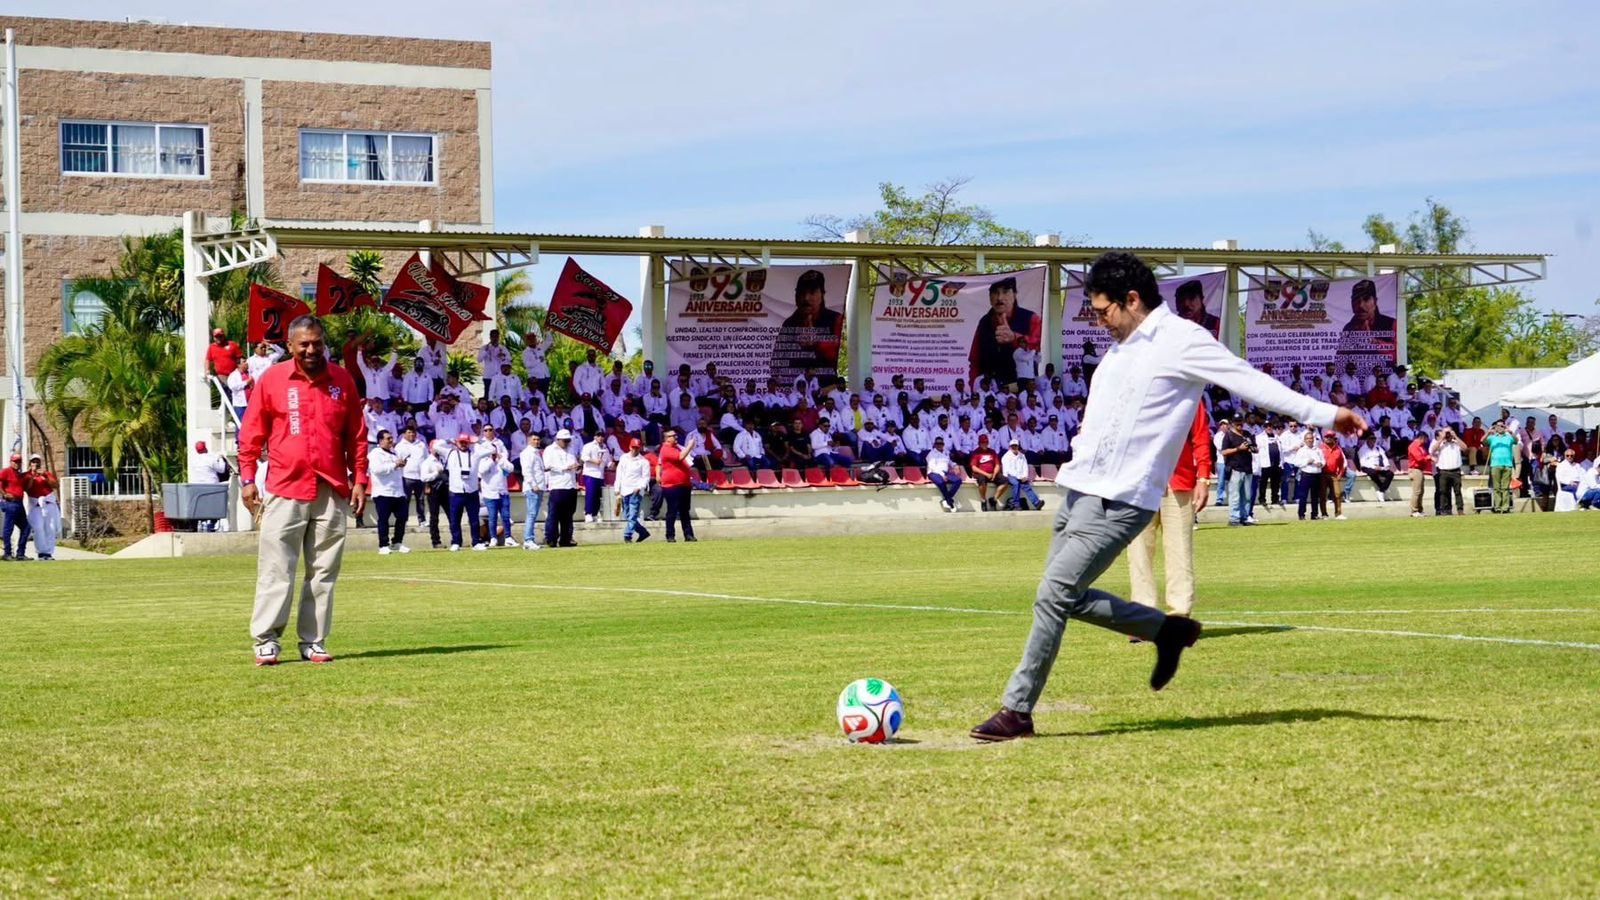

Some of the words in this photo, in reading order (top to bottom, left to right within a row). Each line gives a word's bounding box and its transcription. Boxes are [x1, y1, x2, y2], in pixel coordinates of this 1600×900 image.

[685, 301, 763, 312] ANIVERSARIO
[883, 306, 959, 318] ANIVERSARIO
[933, 367, 965, 375] MORALES
[288, 387, 299, 410] VICTOR
[289, 411, 300, 436] FLORES
